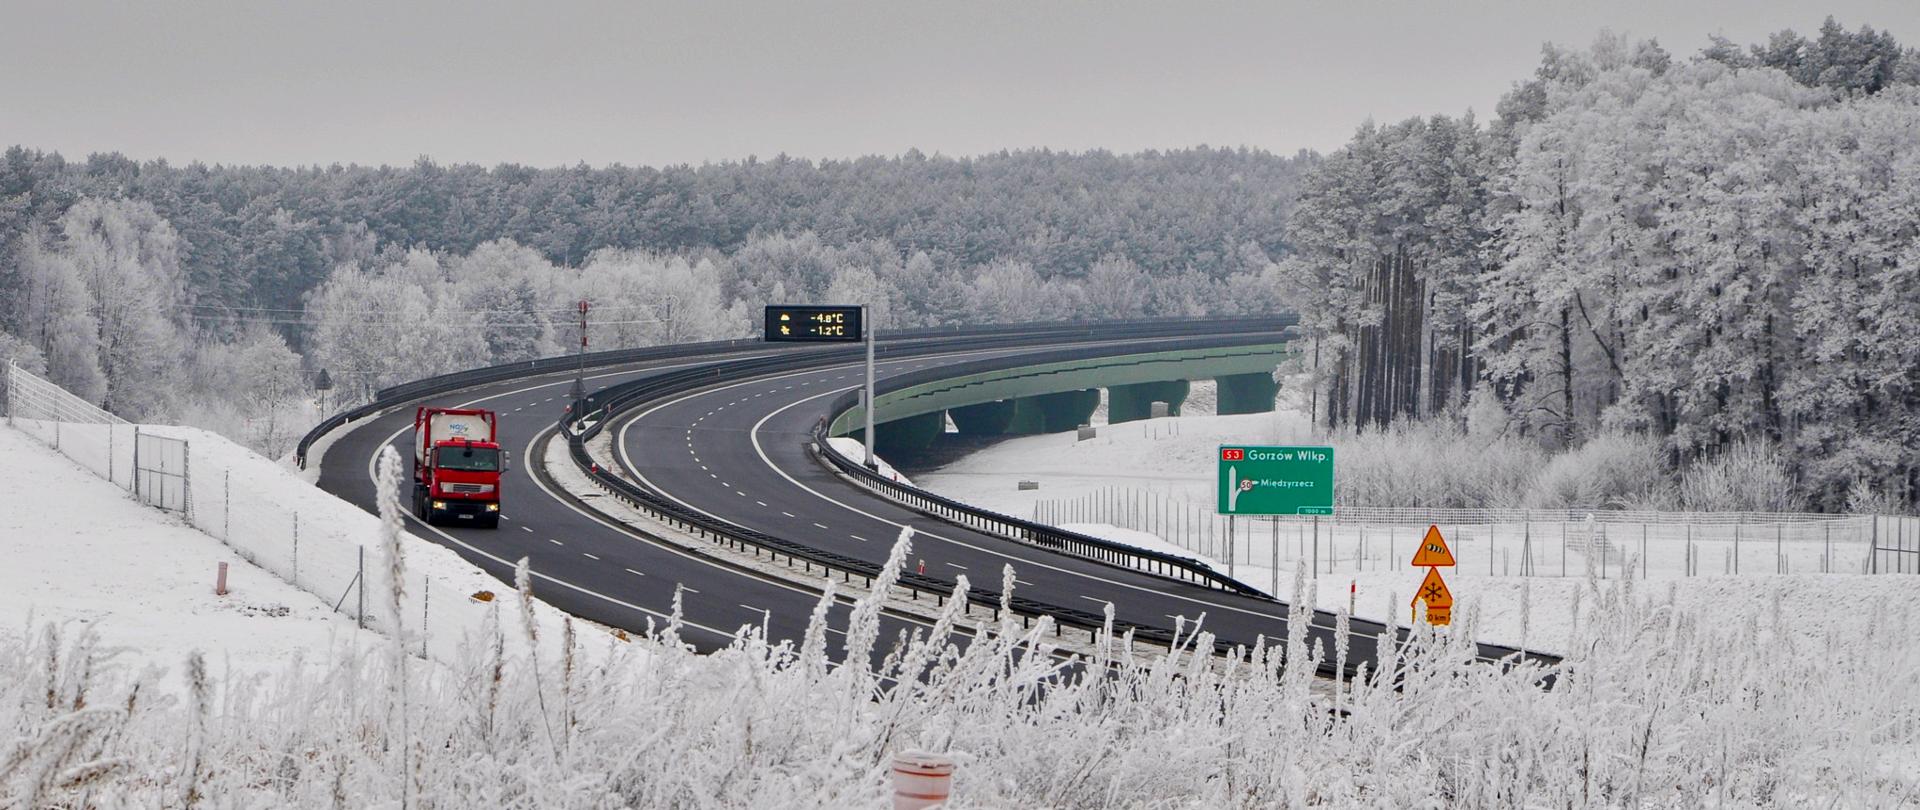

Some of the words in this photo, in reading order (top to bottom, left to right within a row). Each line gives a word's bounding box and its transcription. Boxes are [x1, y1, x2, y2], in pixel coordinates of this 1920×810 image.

[1248, 449, 1293, 460] Gorzów
[1297, 450, 1329, 463] Wlkp.
[1260, 479, 1314, 488] Międzyrzecz
